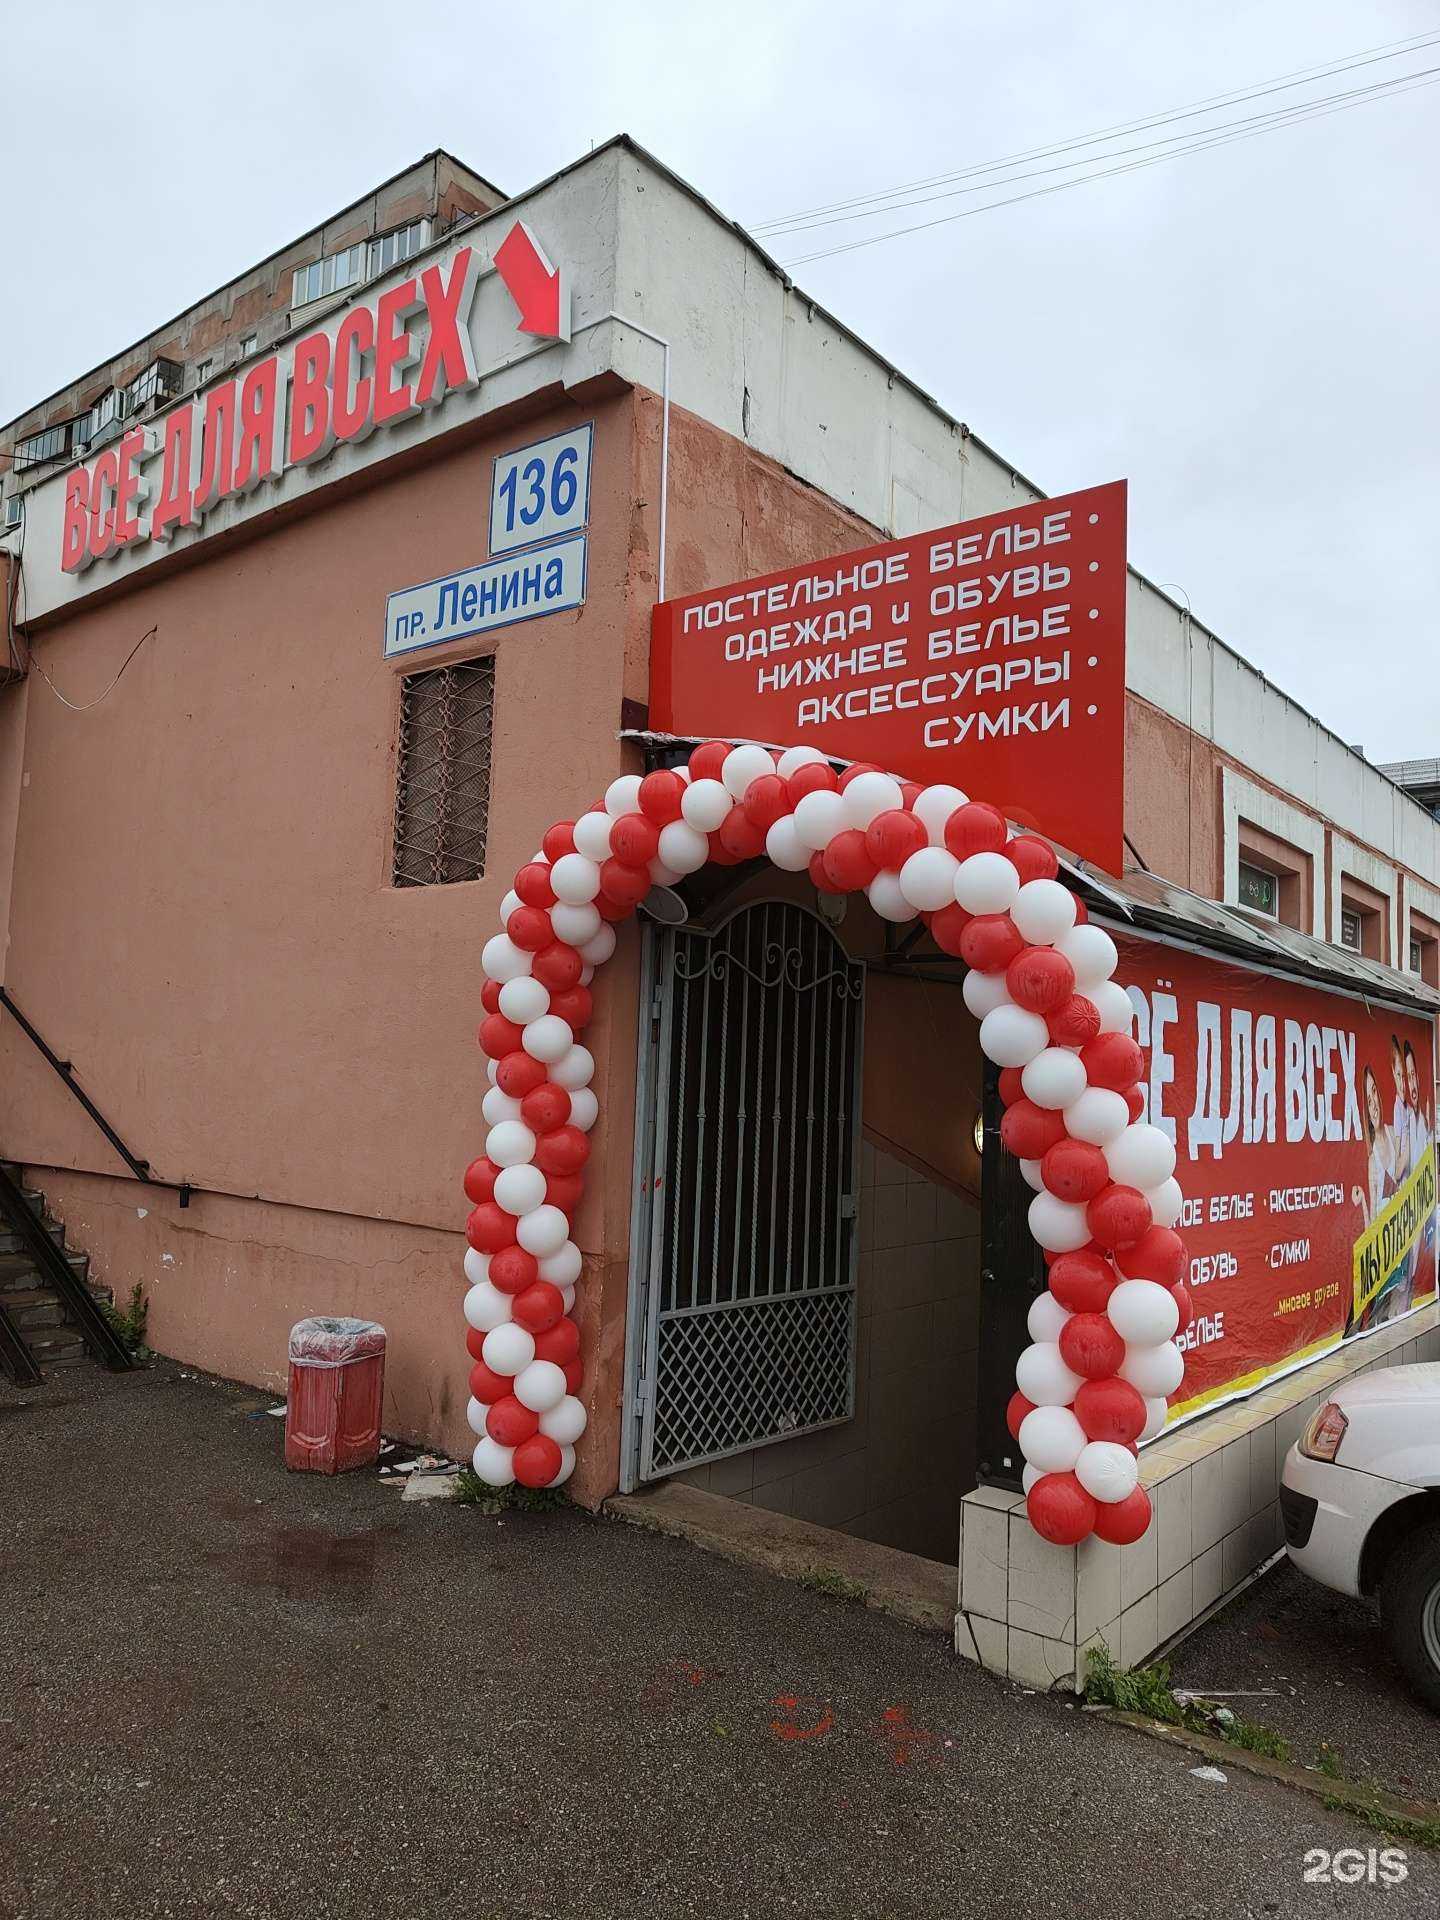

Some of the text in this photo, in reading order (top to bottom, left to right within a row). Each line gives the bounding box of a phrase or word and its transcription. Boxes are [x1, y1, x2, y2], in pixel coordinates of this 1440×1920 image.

[152, 356, 284, 542] ДЛЯ
[290, 246, 477, 463] ВСЕХ
[499, 447, 578, 532] 136
[433, 557, 563, 630] Ленина
[684, 510, 1071, 633] ПОСТЕЛЬНОЕ БЕЛЬЕ
[725, 604, 872, 661] ОДЕЖДА
[931, 561, 1071, 617] ОБУВЬ
[758, 603, 1071, 694] НИЖНЕЕ БЕЛЬЕ
[798, 651, 1071, 727] АКСЕССУАРЫ
[924, 699, 1071, 749] СУМКИ
[1188, 1001, 1276, 1160] ДЛЯ
[1285, 1019, 1363, 1143] ВСЕХ
[1209, 1193, 1254, 1223] БЕЛЬЕ
[1270, 1183, 1344, 1213] АКСЕССУАРЫ
[1360, 1166, 1434, 1300] МЫ ОТКРЫЛИСЬ
[1190, 1252, 1238, 1286] ОБУВЬ
[1270, 1239, 1311, 1268] СУМКИ
